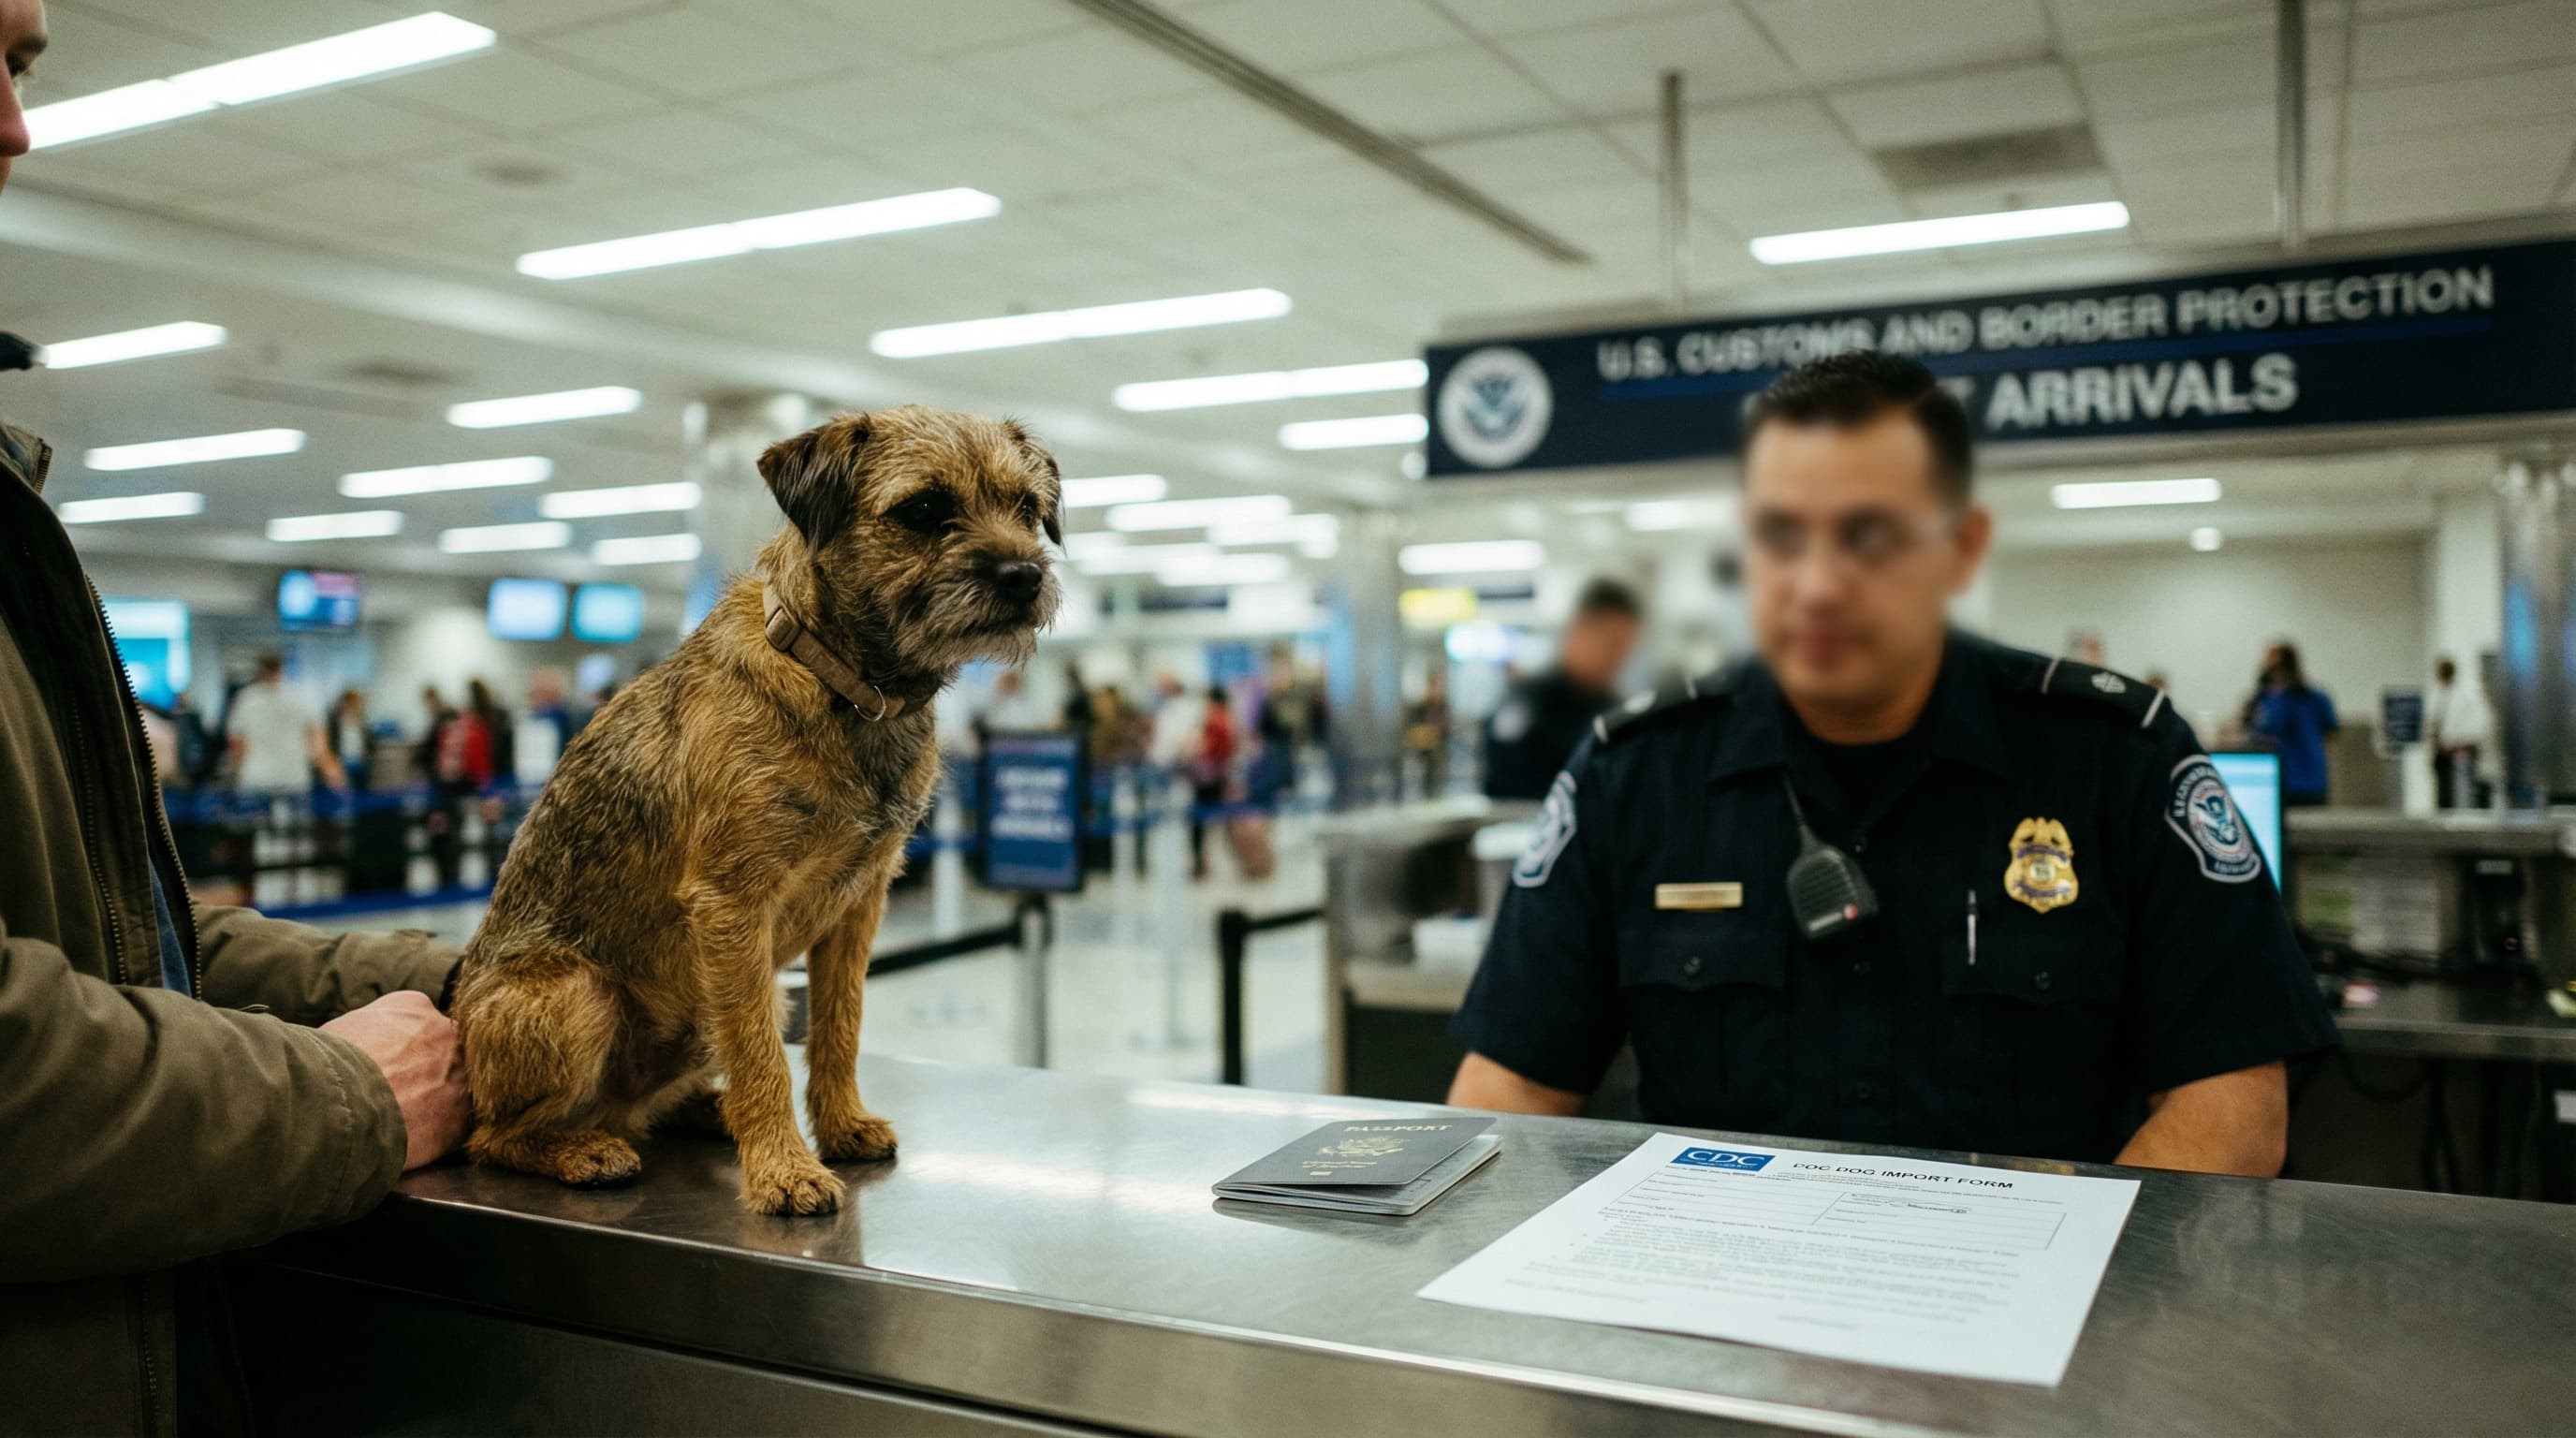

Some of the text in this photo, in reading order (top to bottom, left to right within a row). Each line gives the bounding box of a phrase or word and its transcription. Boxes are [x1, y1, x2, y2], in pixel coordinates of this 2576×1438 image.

[1596, 336, 1673, 381] U.S.
[1881, 309, 1976, 355] AND
[1978, 294, 2169, 352] BORDER
[2176, 266, 2495, 333] PROTECTION
[1984, 352, 2299, 431] ARRIVALS
[1687, 1151, 1764, 1167] CDC
[1881, 1170, 1954, 1183] IMPORT
[1957, 1178, 2013, 1190] FORM
